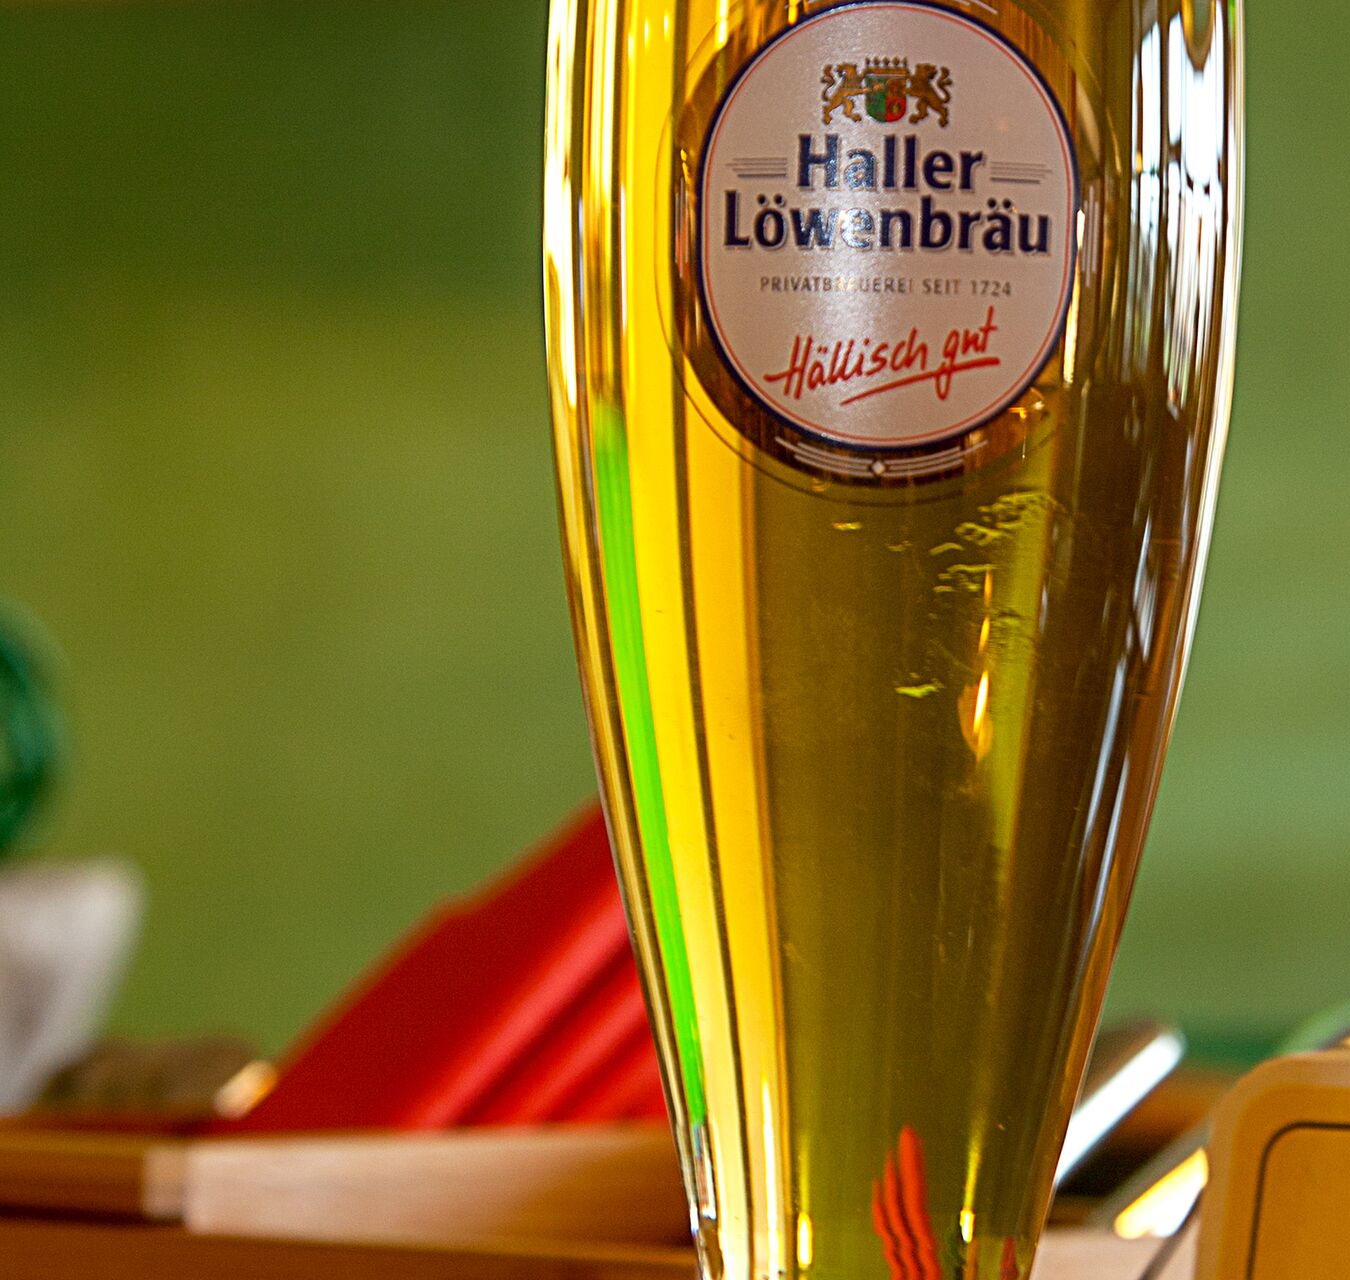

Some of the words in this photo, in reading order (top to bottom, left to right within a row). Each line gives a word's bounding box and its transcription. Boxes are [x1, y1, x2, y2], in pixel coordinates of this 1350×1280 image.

[797, 133, 984, 192] Haller
[722, 190, 1050, 254] Löwenbräu
[922, 277, 961, 296] SEIT
[971, 279, 1012, 297] 1724
[763, 327, 929, 400] Hällisch
[934, 305, 999, 401] gut
